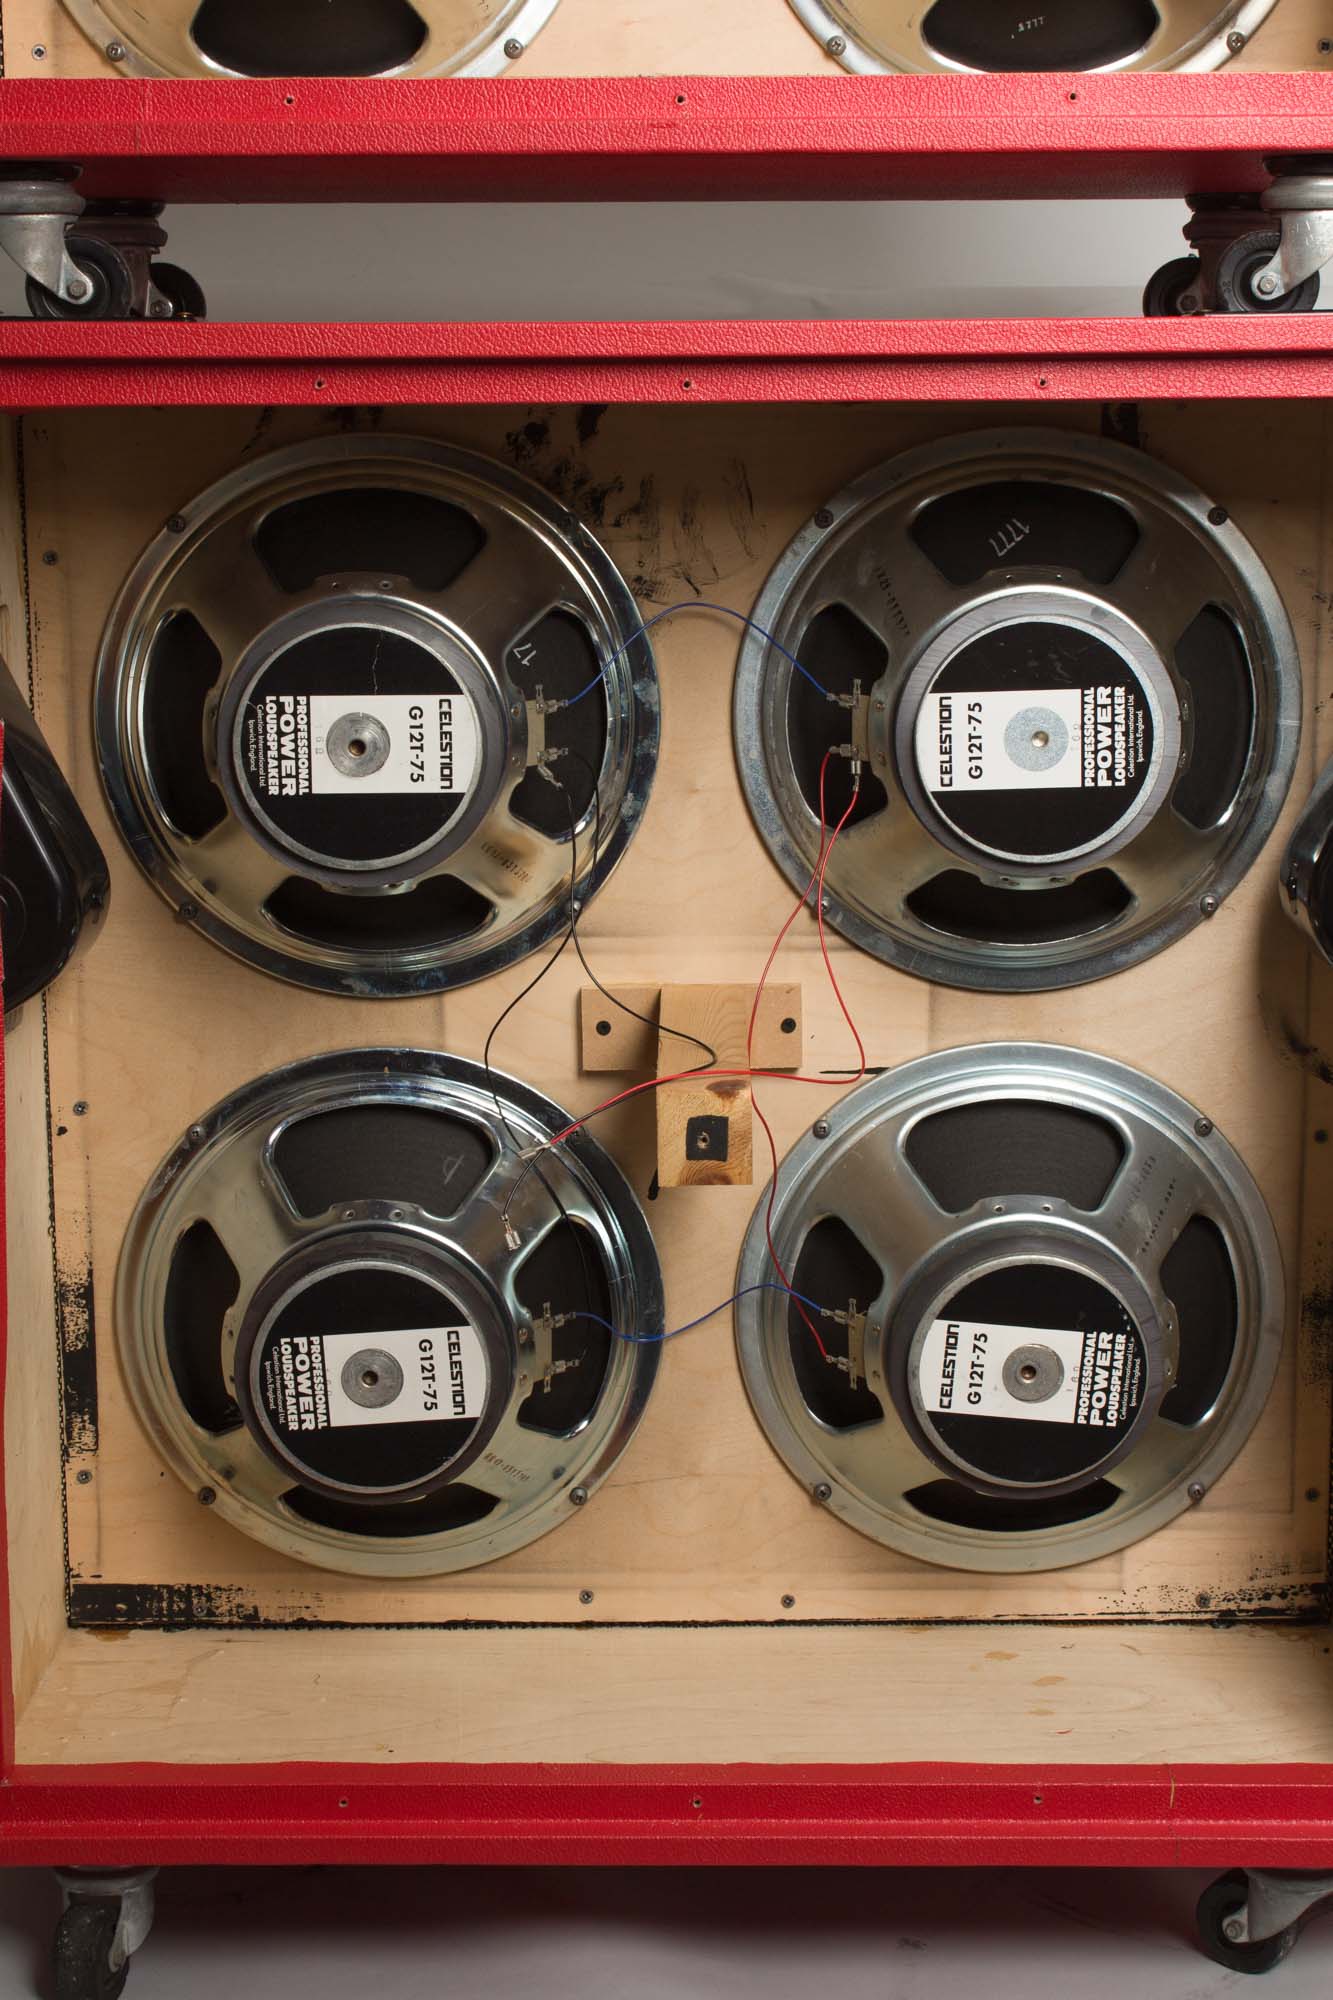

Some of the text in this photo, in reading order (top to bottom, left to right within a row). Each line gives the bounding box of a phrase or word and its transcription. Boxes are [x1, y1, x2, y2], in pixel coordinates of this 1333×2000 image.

[256, 704, 264, 734] Celestion
[266, 696, 279, 795] LOUDSPEAKER
[280, 696, 296, 796] POWER
[297, 696, 309, 795] PROFESSIONAL
[408, 705, 424, 783] G12T-75
[438, 698, 453, 790] CELESTION
[939, 696, 952, 787] CELESTION
[968, 702, 982, 779] G12T-75
[1084, 687, 1095, 787] PROFESSIONAL
[1097, 686, 1112, 787] POWER
[1114, 686, 1126, 786] LOUDSPEAKER
[272, 1346, 280, 1374] Celestion
[280, 1338, 299, 1431] LOUDSPEAKER
[293, 1337, 315, 1430] POWER
[310, 1336, 327, 1429] PROFESSIONAL
[418, 1338, 438, 1411] G12T-75
[447, 1330, 466, 1415] CELESTION
[939, 1323, 960, 1409] CELESTION
[967, 1333, 988, 1405] G12T-75
[1077, 1331, 1097, 1424] PROFESSIONAL
[1089, 1331, 1113, 1426] POWER
[1106, 1333, 1127, 1427] LOUDSPEAKER
[1119, 1392, 1129, 1420] Celestion
[1124, 1355, 1133, 1391] International
